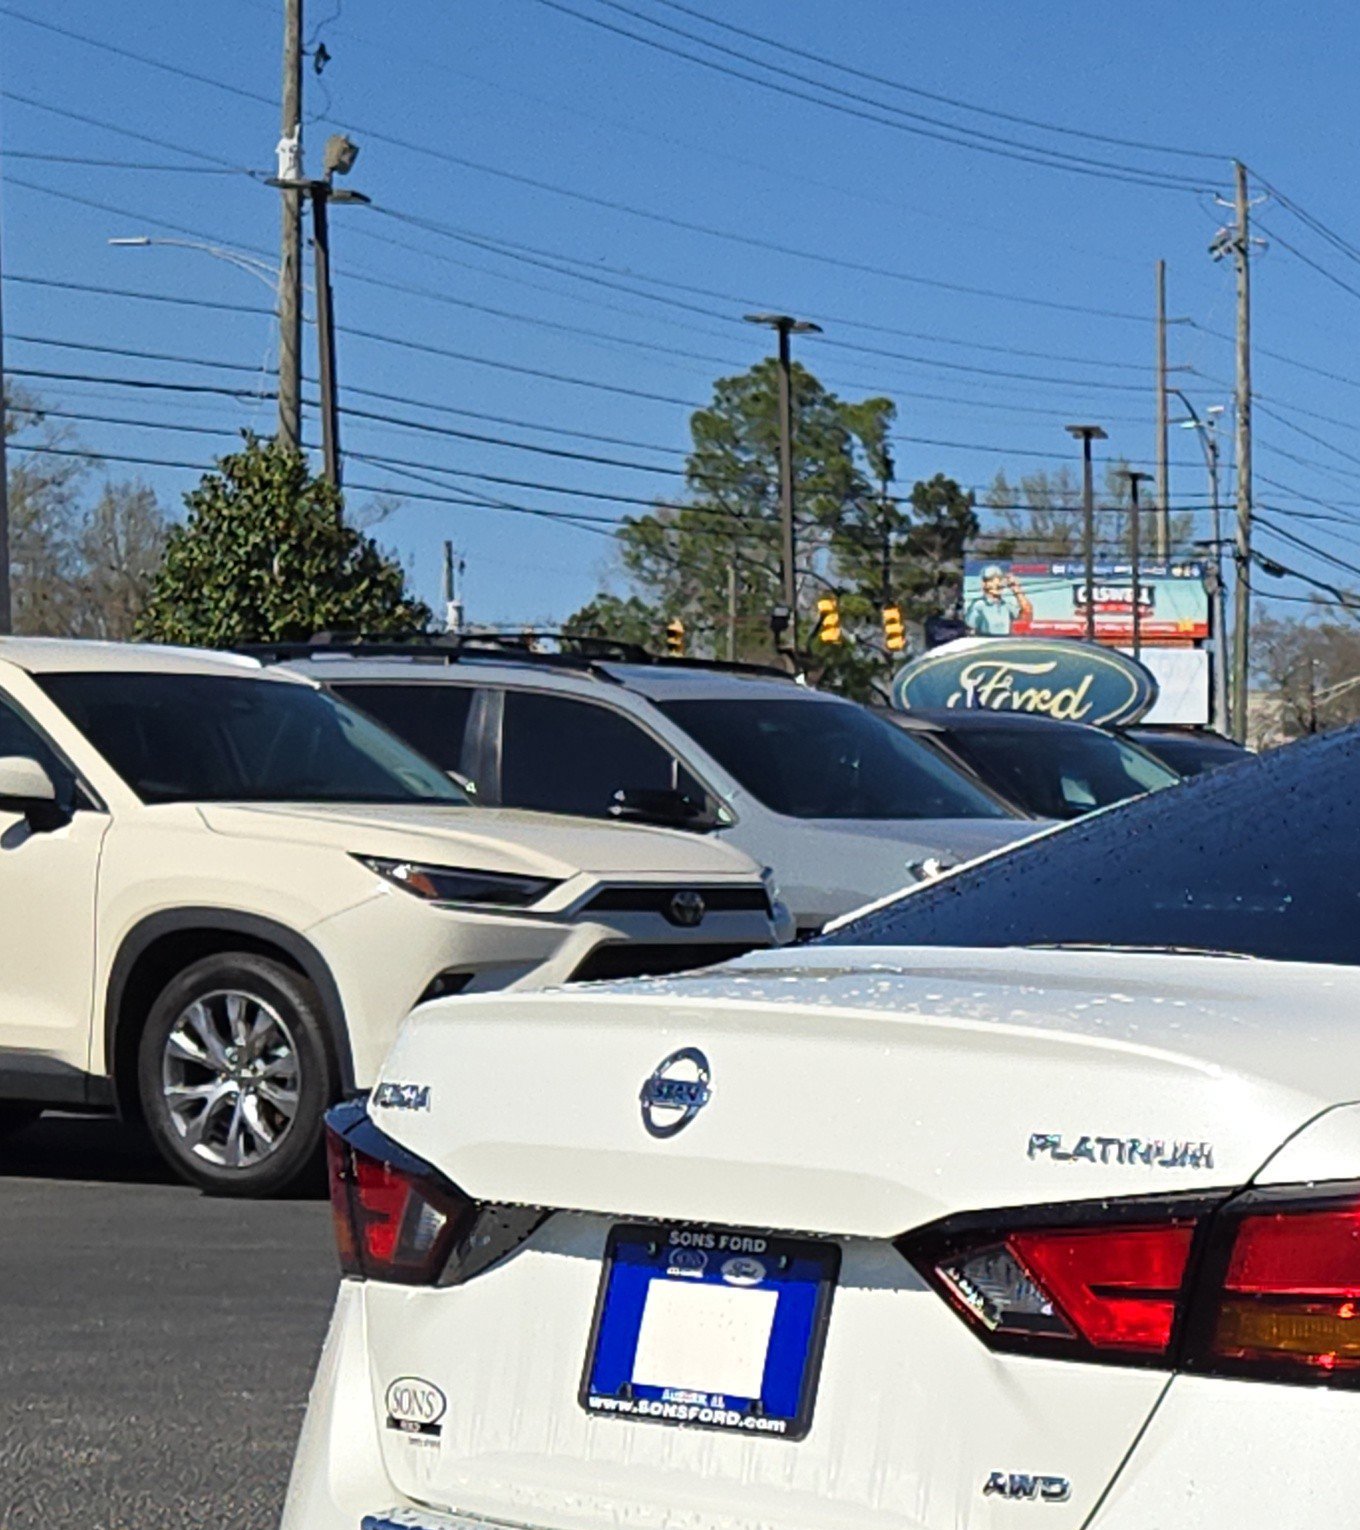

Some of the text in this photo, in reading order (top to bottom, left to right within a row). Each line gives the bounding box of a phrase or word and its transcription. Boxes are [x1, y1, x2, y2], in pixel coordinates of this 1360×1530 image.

[947, 660, 1094, 720] Ford
[1027, 1133, 1214, 1169] PLATINUM
[669, 1230, 768, 1253] SONS FORD
[392, 1386, 436, 1420] SONS
[589, 1396, 787, 1434] www.SONSFORD.com
[983, 1471, 1072, 1503] AWD
